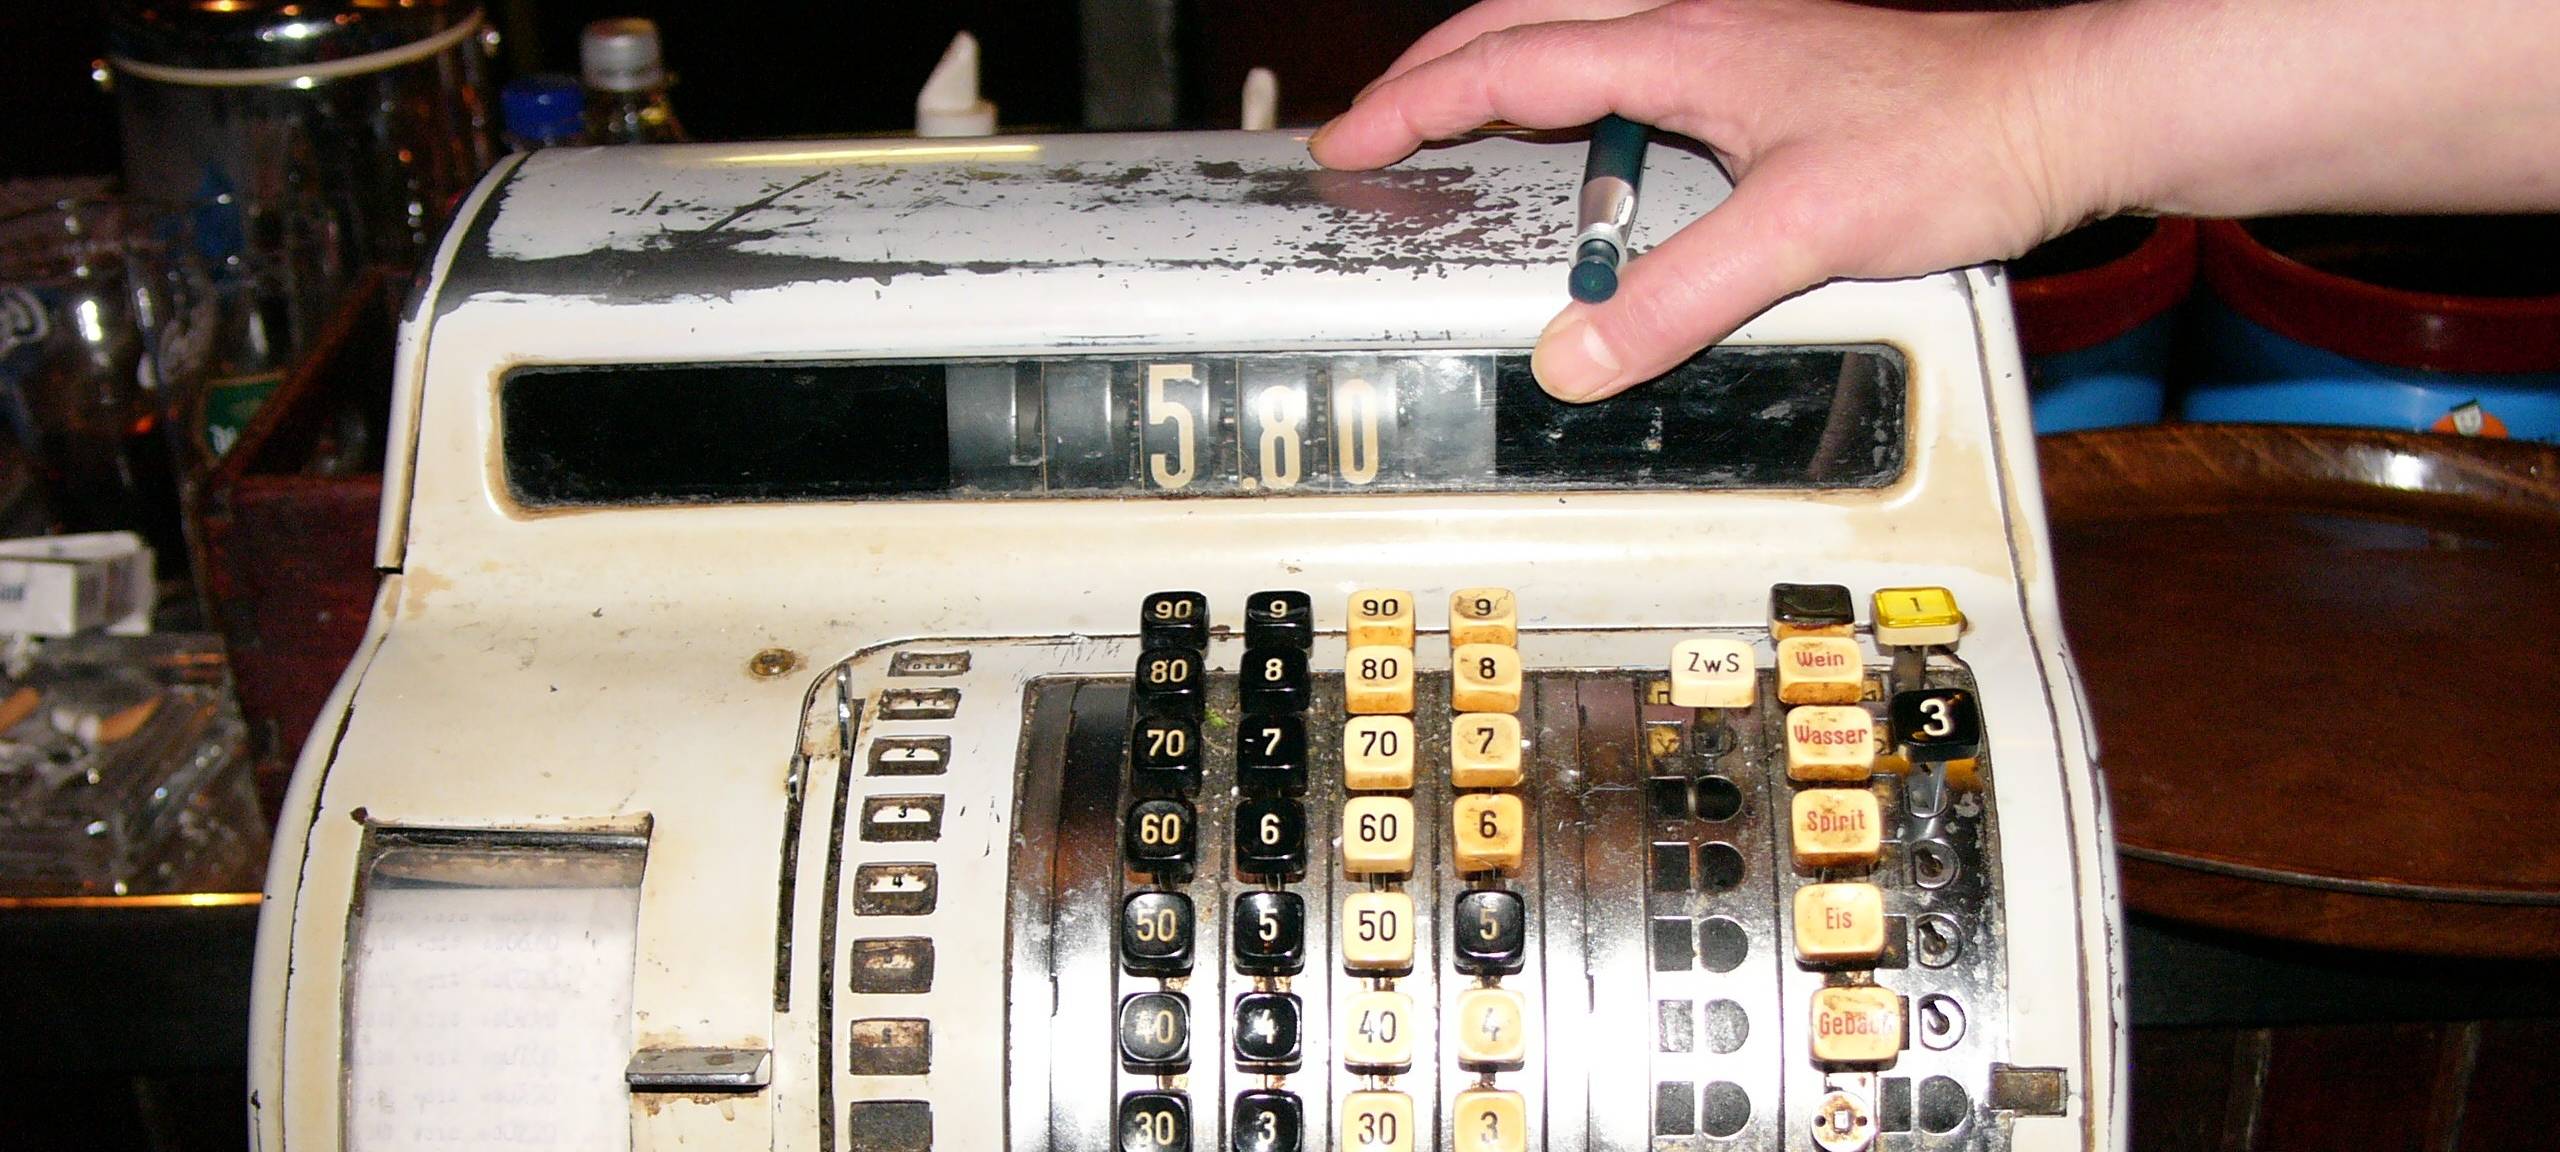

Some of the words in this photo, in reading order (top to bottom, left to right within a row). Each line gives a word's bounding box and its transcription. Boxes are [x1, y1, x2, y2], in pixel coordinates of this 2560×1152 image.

[1155, 600, 1193, 619] 90
[1269, 600, 1288, 619] 9
[1362, 599, 1399, 616] 90
[1474, 599, 1492, 616] 9
[1909, 597, 1921, 612] 1
[1150, 658, 1188, 683] 80
[1265, 658, 1282, 681] 8
[1362, 658, 1398, 680] 80
[1479, 657, 1496, 680] 8
[1687, 652, 1740, 673] ZwS
[1796, 651, 1845, 667] Wein
[1919, 698, 1951, 737] 3
[1147, 728, 1186, 757] 70
[1262, 728, 1281, 756] 7
[1360, 730, 1398, 757] 70
[1477, 728, 1495, 754] 7
[1793, 724, 1868, 745] Wasser
[1140, 813, 1180, 845] 60
[1260, 813, 1280, 845] 6
[1359, 813, 1397, 842] 60
[1479, 810, 1497, 839] 6
[1807, 808, 1866, 833] Spirit
[1136, 909, 1177, 942] 50
[1259, 909, 1278, 942] 5
[1358, 910, 1397, 941] 50
[1479, 909, 1498, 940] 5
[1826, 908, 1853, 930] Eis
[1136, 1009, 1175, 1044] 40
[1252, 1010, 1279, 1045] 4
[1358, 1011, 1397, 1043] 40
[1481, 1008, 1499, 1042] 4
[1135, 1111, 1175, 1146] 30
[1257, 1112, 1277, 1144] 3
[1358, 1112, 1397, 1145] 30
[1480, 1111, 1499, 1142] 3
